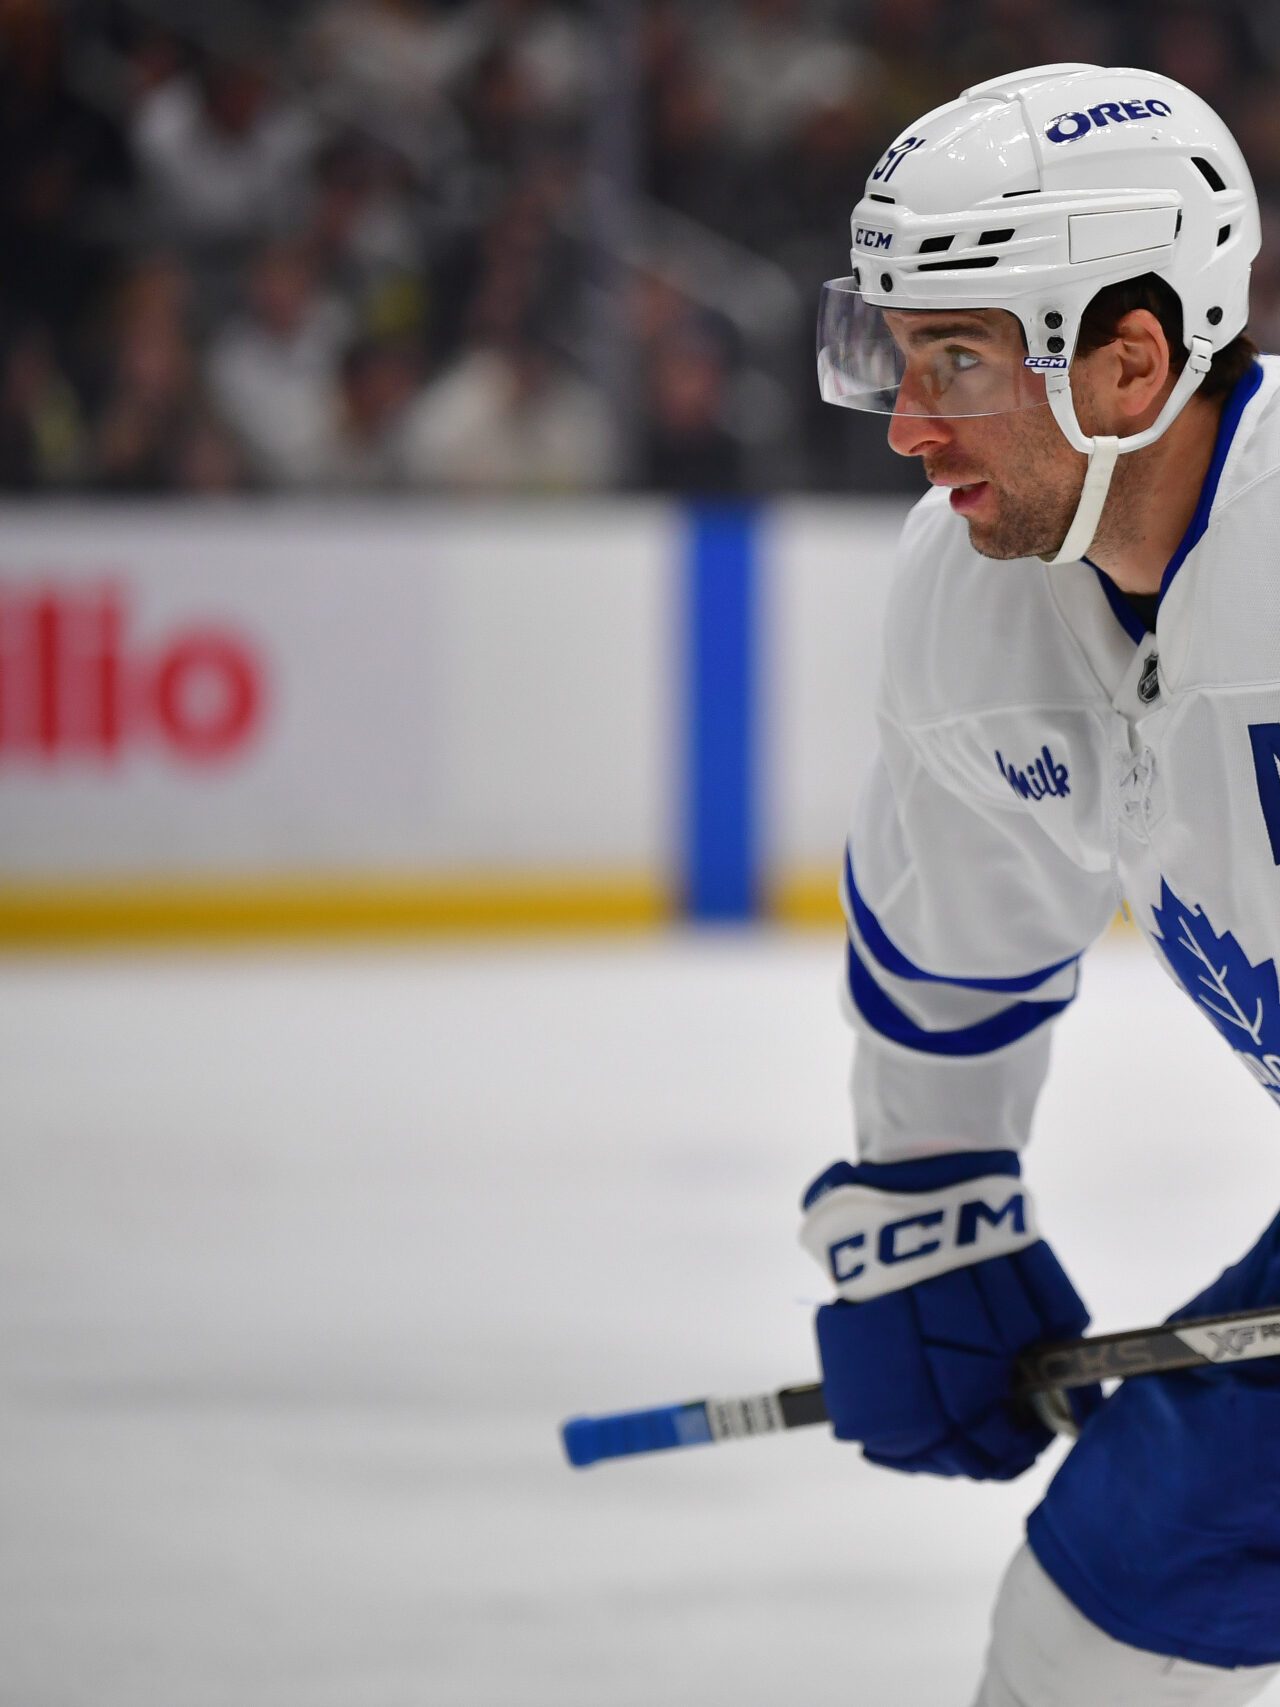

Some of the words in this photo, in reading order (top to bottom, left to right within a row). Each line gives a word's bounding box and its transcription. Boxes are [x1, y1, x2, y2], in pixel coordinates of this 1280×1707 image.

[1045, 99, 1172, 144] OREO
[855, 228, 893, 250] CCM
[1025, 357, 1066, 367] CCM
[828, 1193, 1026, 1283] CCM
